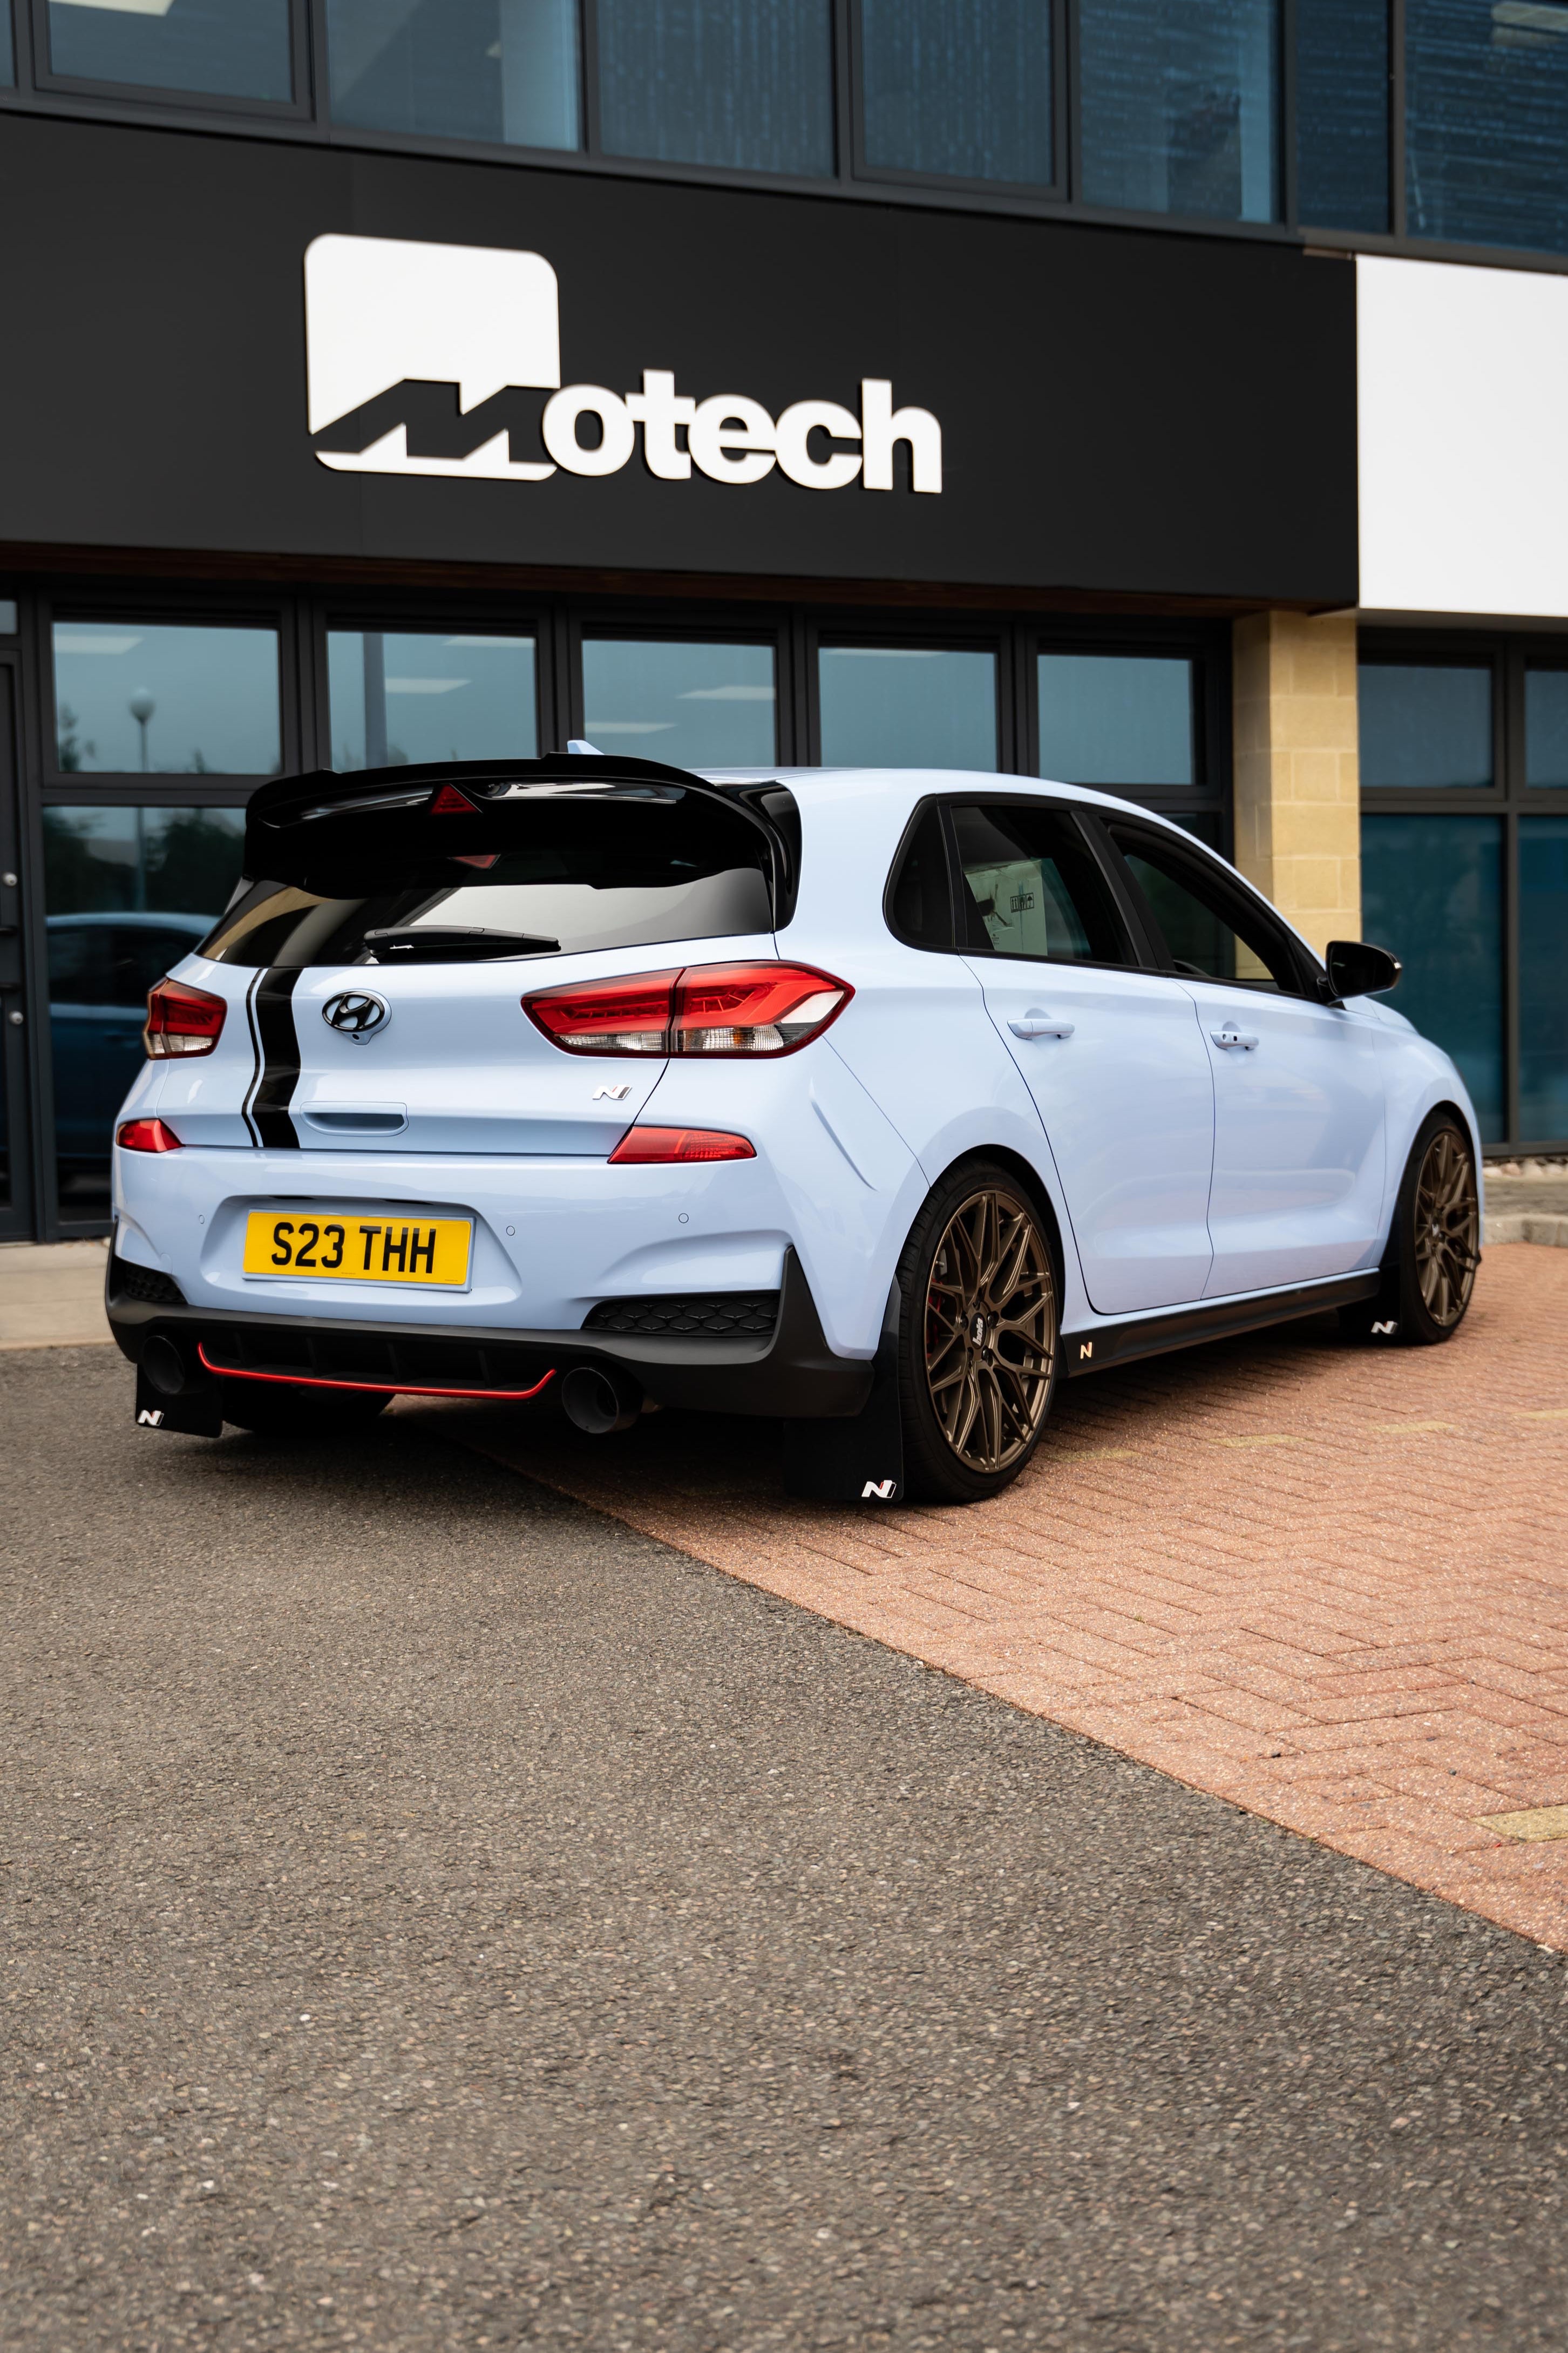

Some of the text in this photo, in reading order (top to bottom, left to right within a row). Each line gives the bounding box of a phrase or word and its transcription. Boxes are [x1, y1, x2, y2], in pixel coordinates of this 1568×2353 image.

[271, 1222, 436, 1274] S23 THH
[1080, 1342, 1092, 1359] N
[861, 1479, 897, 1498] N
